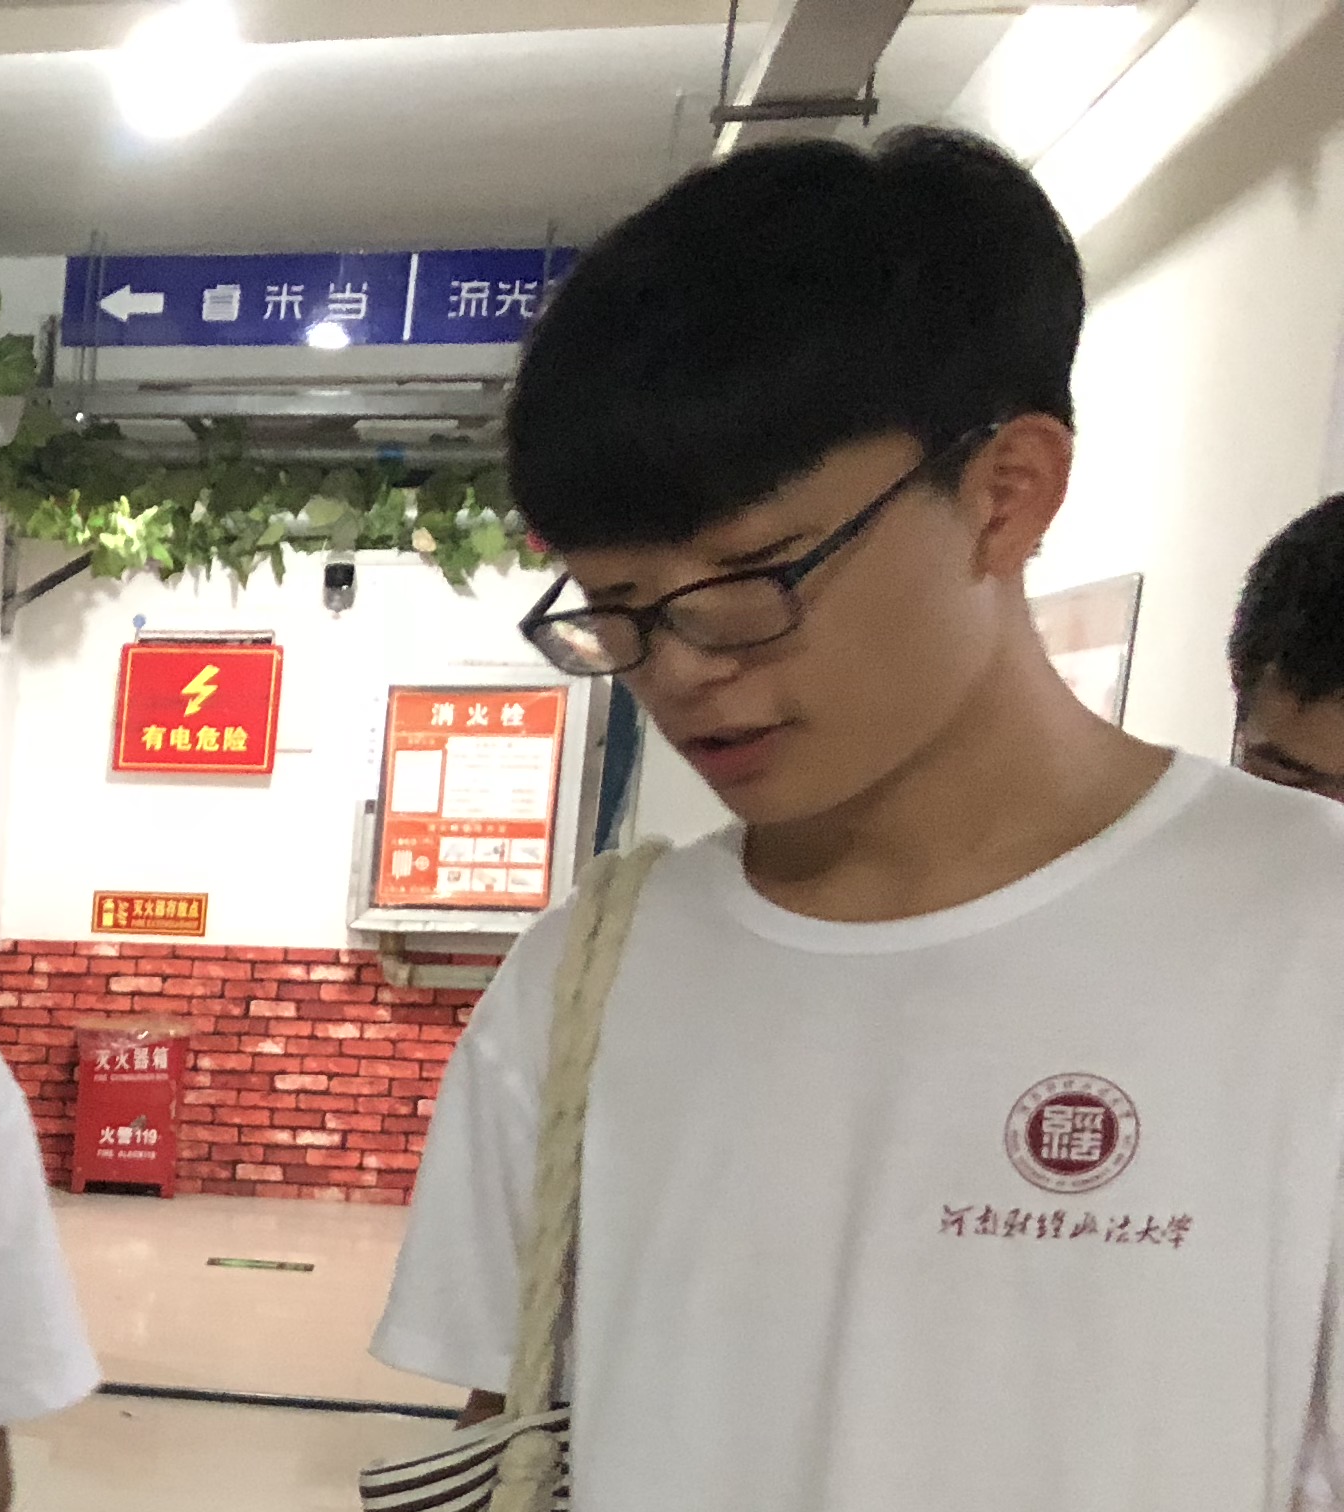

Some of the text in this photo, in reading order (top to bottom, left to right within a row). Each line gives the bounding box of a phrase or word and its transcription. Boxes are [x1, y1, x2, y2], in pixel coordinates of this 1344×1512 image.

[447, 280, 554, 318] 流光
[430, 702, 525, 727] 消火栓
[141, 724, 248, 752] 有电危险
[93, 1046, 170, 1072] 灭火器箱
[98, 1126, 159, 1146] 火警119
